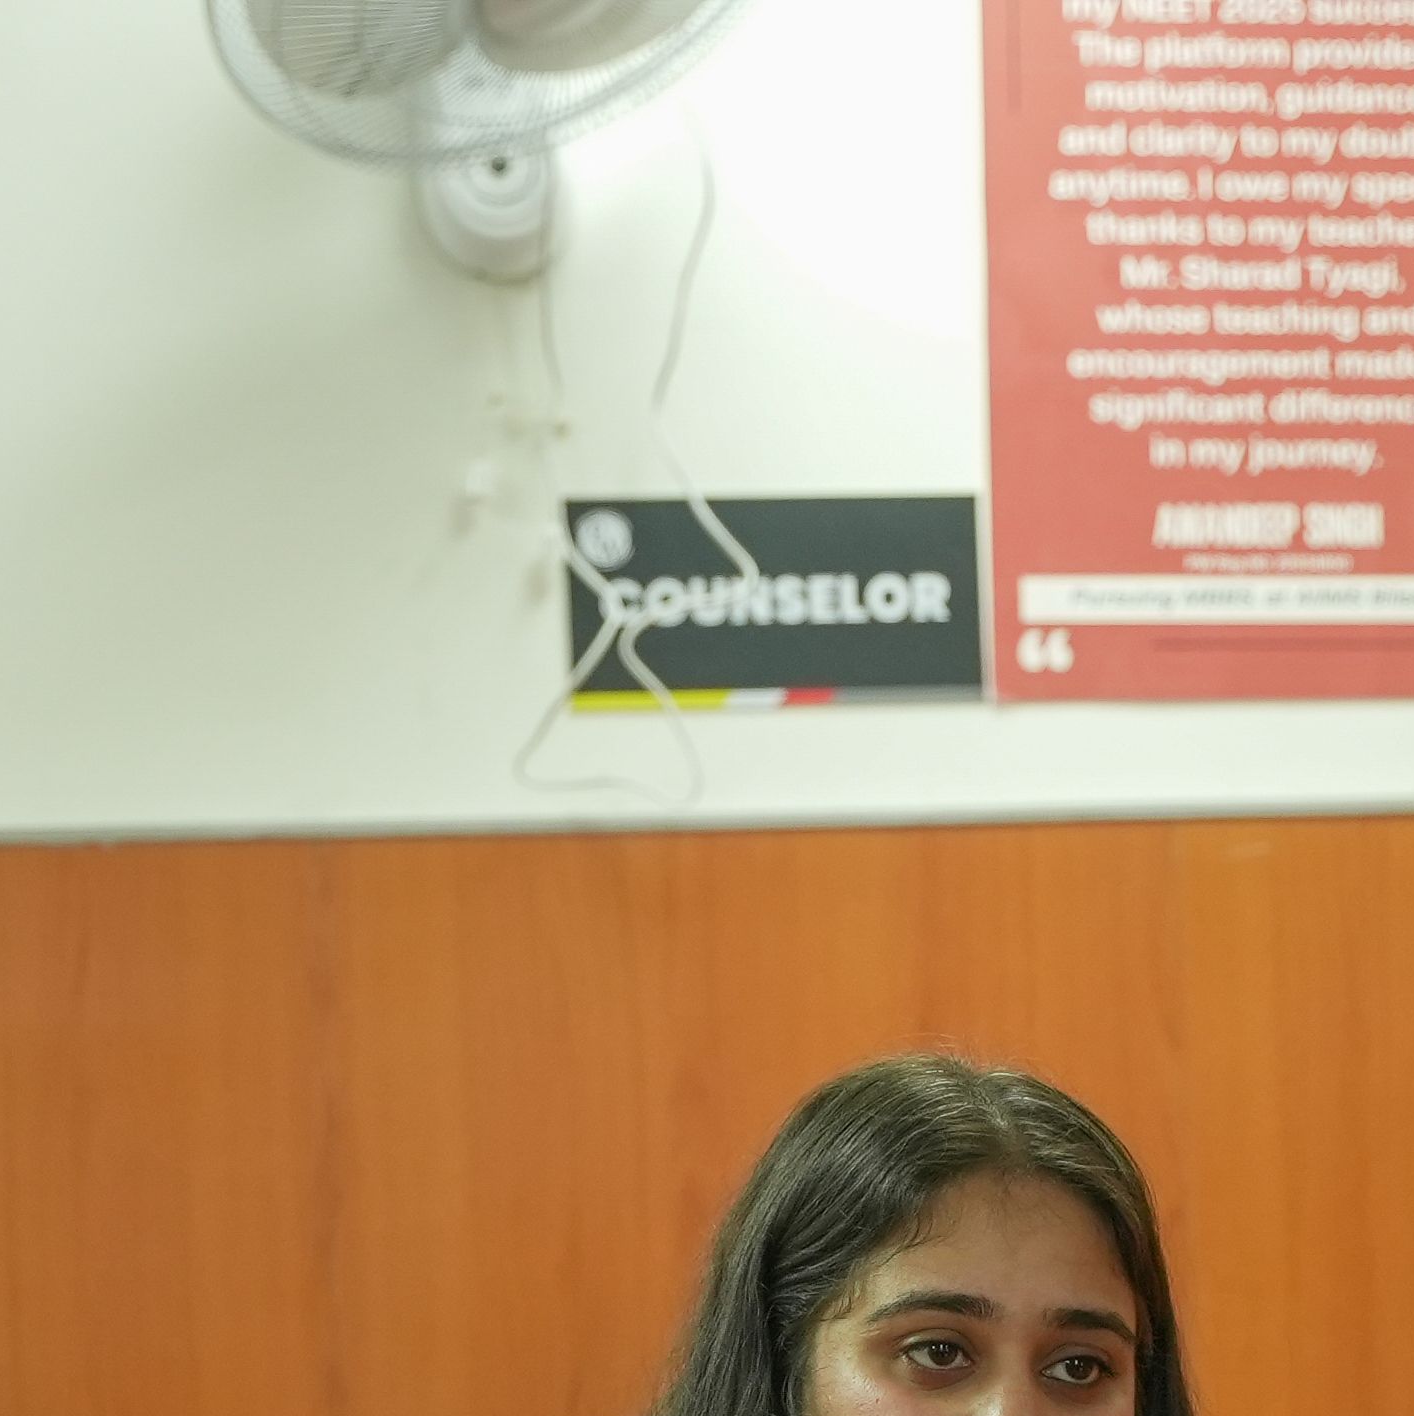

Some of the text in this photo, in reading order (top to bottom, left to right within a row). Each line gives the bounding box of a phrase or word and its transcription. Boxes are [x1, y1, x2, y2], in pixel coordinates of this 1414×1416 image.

[1072, 30, 1142, 68] The
[1144, 30, 1290, 73] platform
[1085, 75, 1274, 116] motivation,
[1058, 119, 1127, 156] and
[1129, 119, 1239, 164] clarity
[1239, 122, 1279, 158] to
[1281, 126, 1338, 165] my
[1197, 166, 1214, 200] I
[1214, 170, 1290, 201] owe
[1291, 170, 1349, 209] my
[1085, 208, 1205, 247] thanks
[1206, 211, 1246, 247] to
[1247, 214, 1306, 253] my
[1119, 254, 1179, 290] Mr.
[1179, 254, 1302, 291] Sharad
[1095, 297, 1211, 334] whose
[1212, 298, 1360, 343] teaching
[1066, 347, 1332, 387] encouragement
[1088, 387, 1266, 431] significant
[1148, 431, 1384, 477] in my journey.
[599, 570, 951, 627] COUNSELOR
